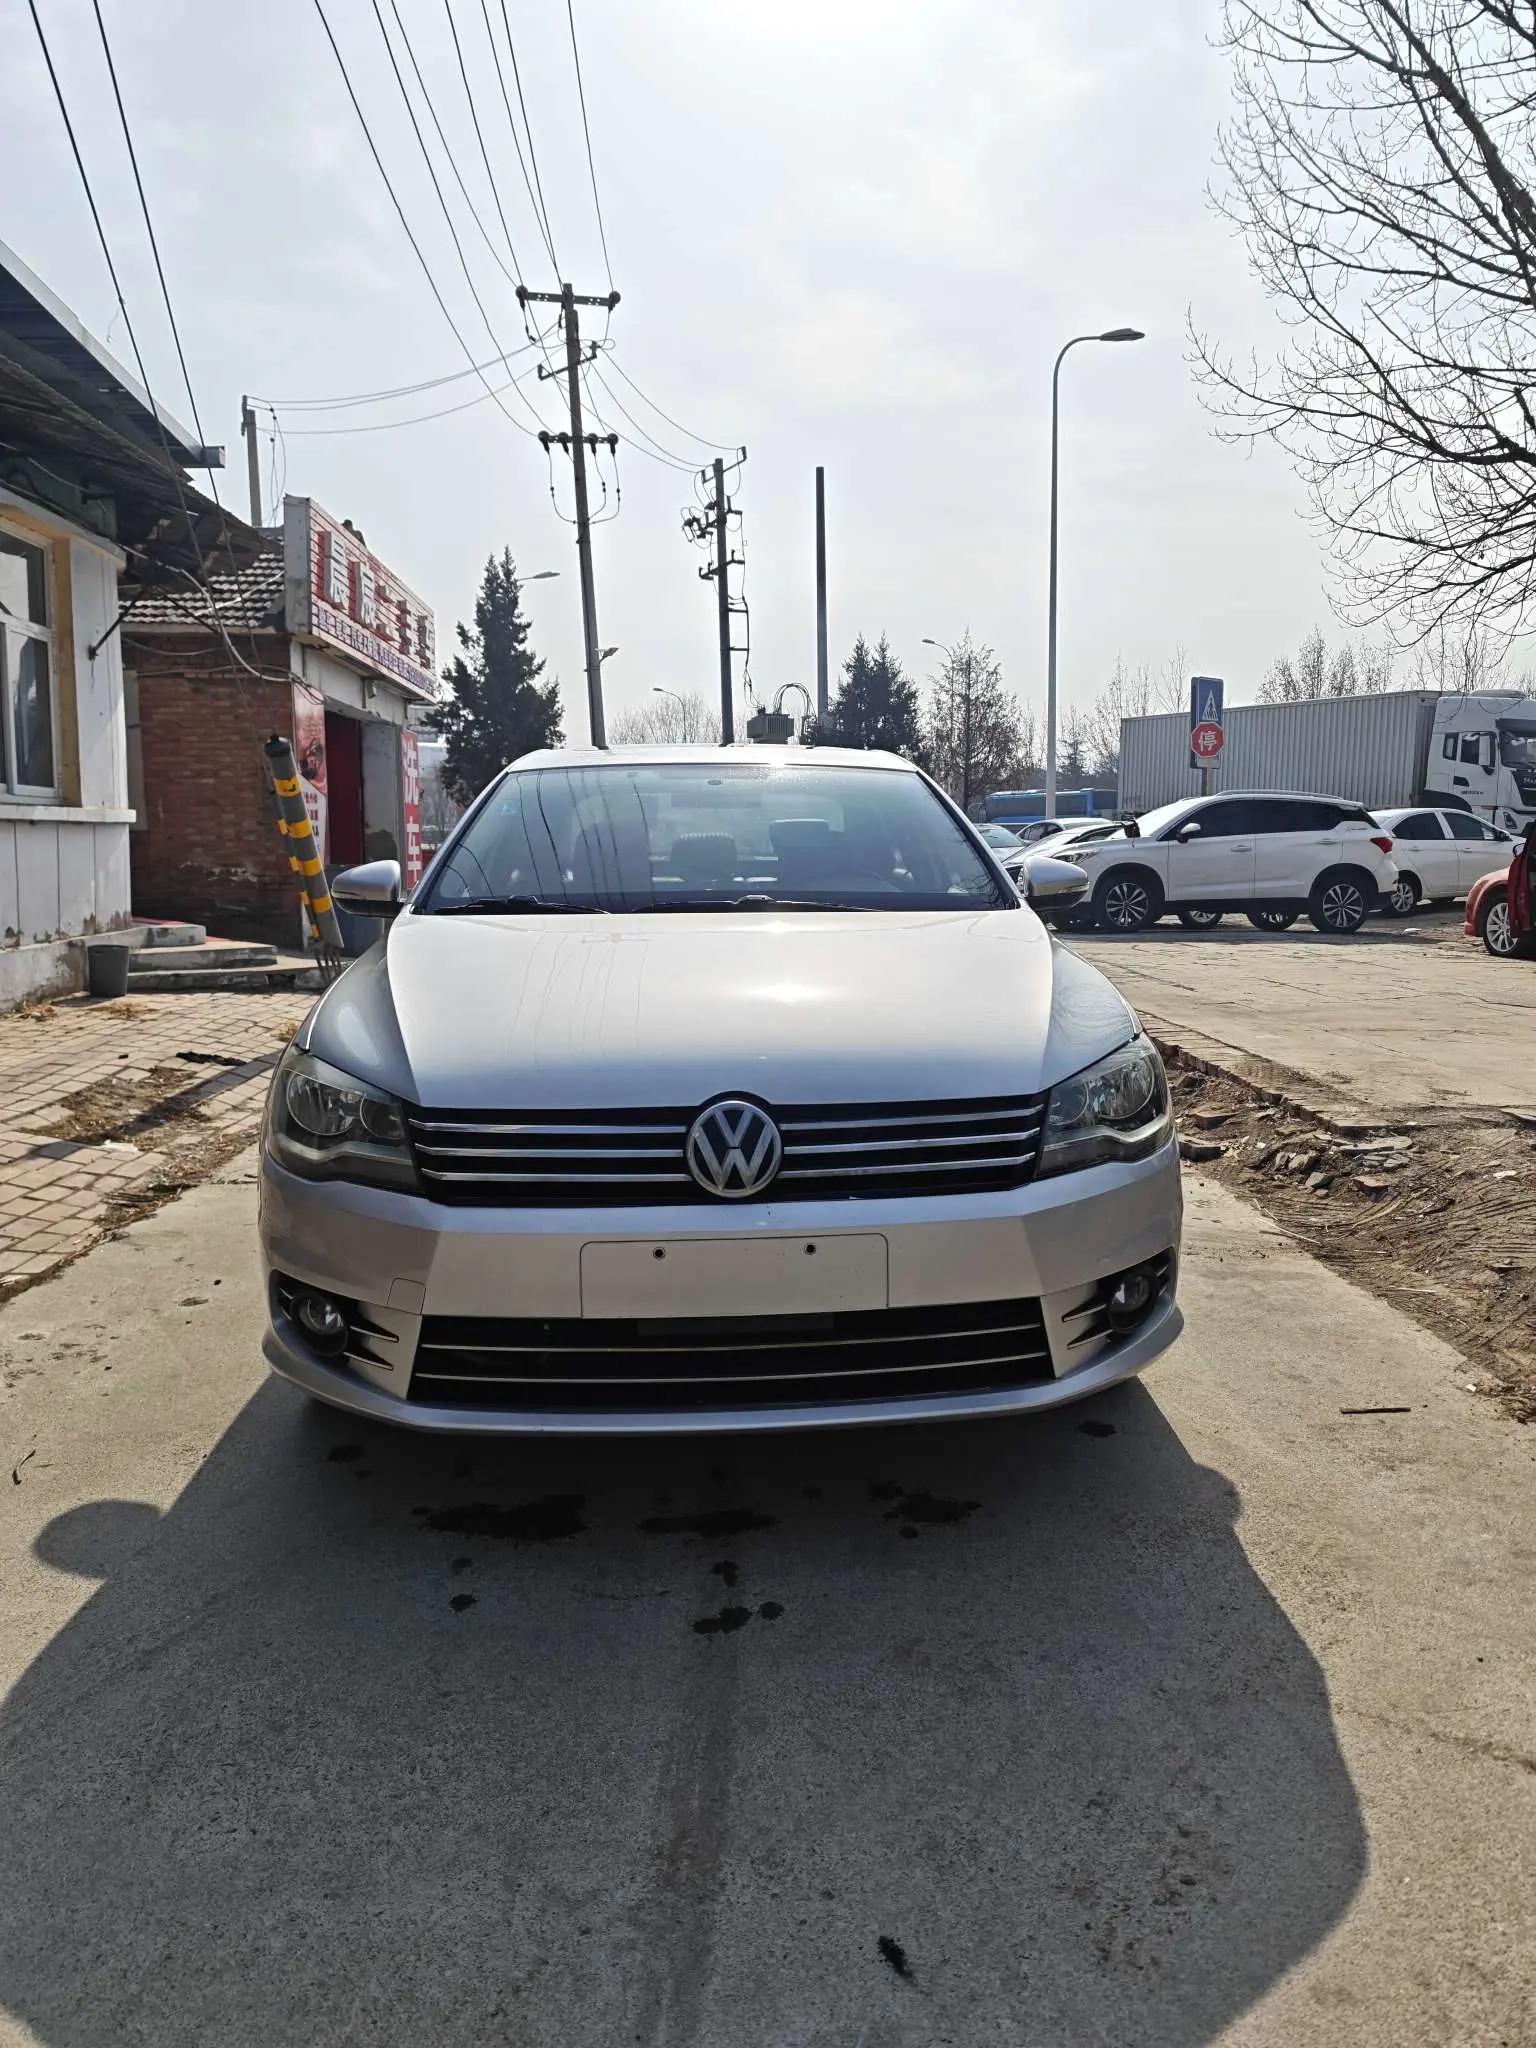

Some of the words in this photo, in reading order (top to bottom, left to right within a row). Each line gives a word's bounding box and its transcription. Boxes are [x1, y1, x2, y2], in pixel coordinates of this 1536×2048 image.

[1198, 730, 1217, 752] 停
[401, 736, 420, 882] 洗车
[689, 1103, 779, 1196] VW
